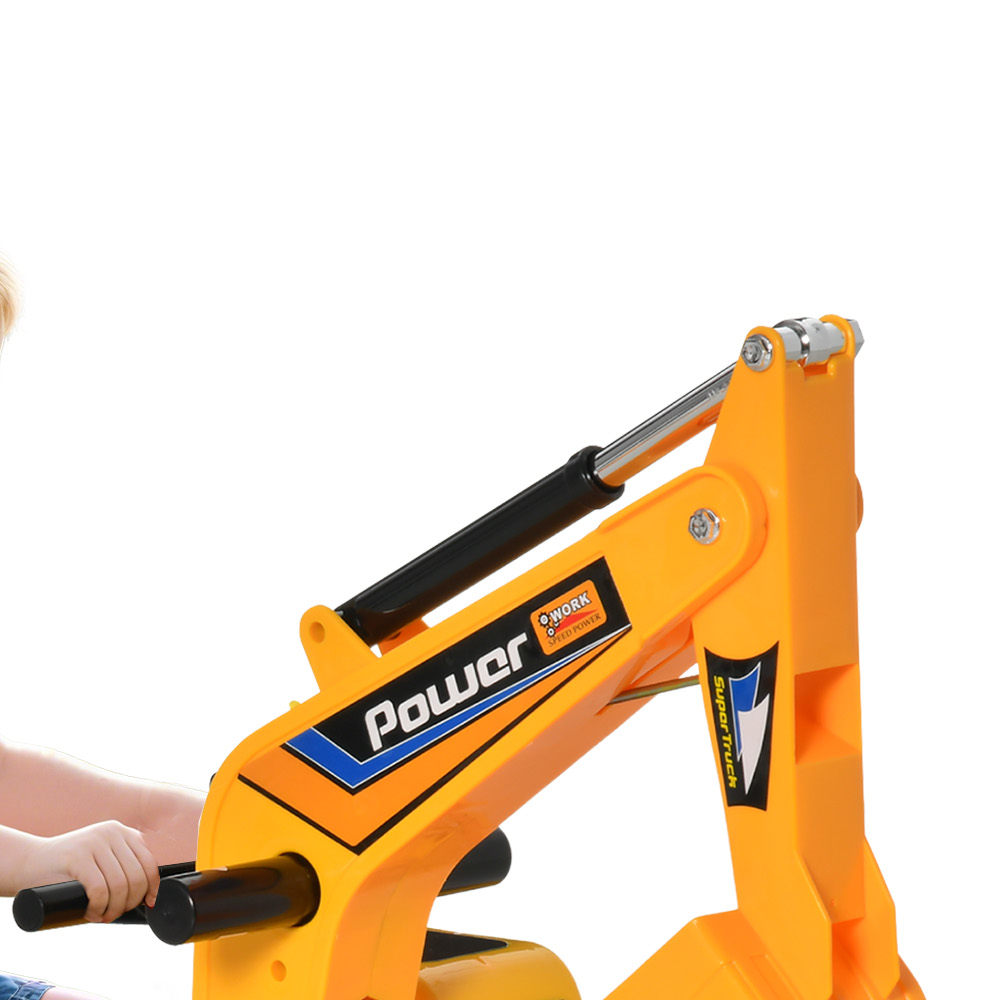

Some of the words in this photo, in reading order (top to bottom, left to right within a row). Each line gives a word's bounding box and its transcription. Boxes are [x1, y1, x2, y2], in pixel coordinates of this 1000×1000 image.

[548, 591, 592, 623] WORK
[548, 629, 573, 647] SPEED
[573, 613, 601, 634] POWER
[364, 632, 528, 752] Power
